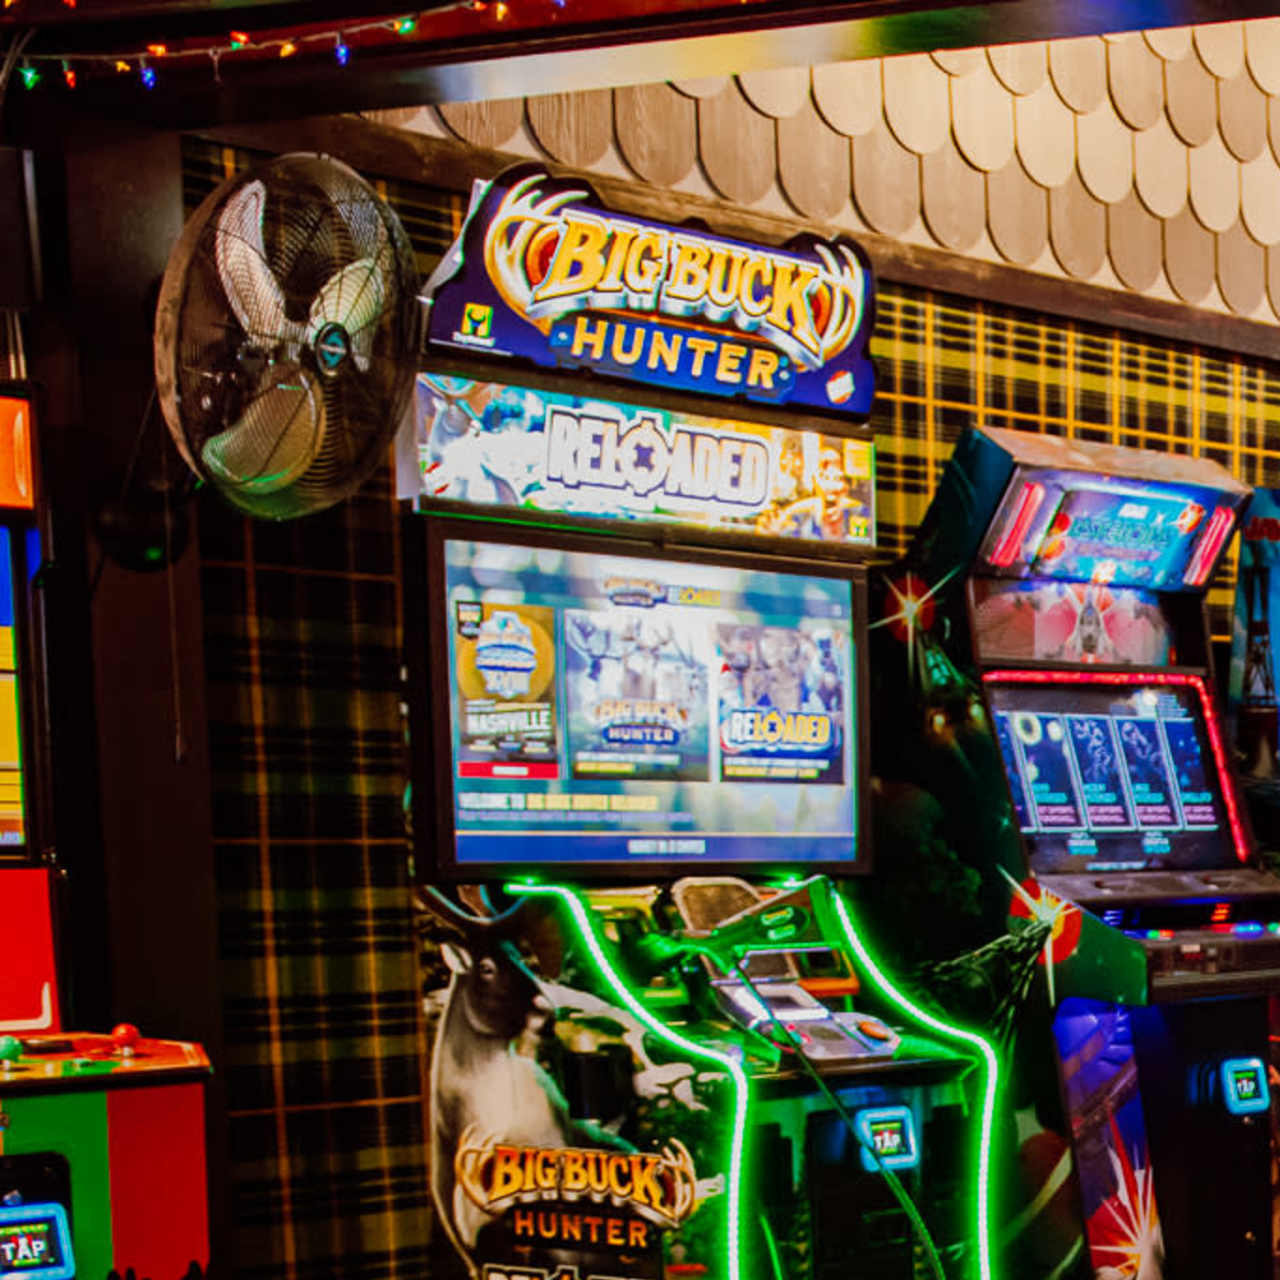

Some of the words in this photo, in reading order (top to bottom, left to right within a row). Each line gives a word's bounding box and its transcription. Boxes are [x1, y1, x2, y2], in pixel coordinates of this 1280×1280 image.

[534, 211, 668, 304] BIG
[664, 238, 824, 360] BUCK
[570, 314, 780, 390] HUNTER
[548, 413, 768, 504] RELOADED
[608, 727, 675, 742] HUNTER
[731, 711, 830, 743] RELOADED
[486, 1148, 558, 1204] BIG
[563, 1151, 678, 1221] BUCK
[1, 1237, 46, 1261] TAP
[514, 1210, 648, 1248] HUNTER
